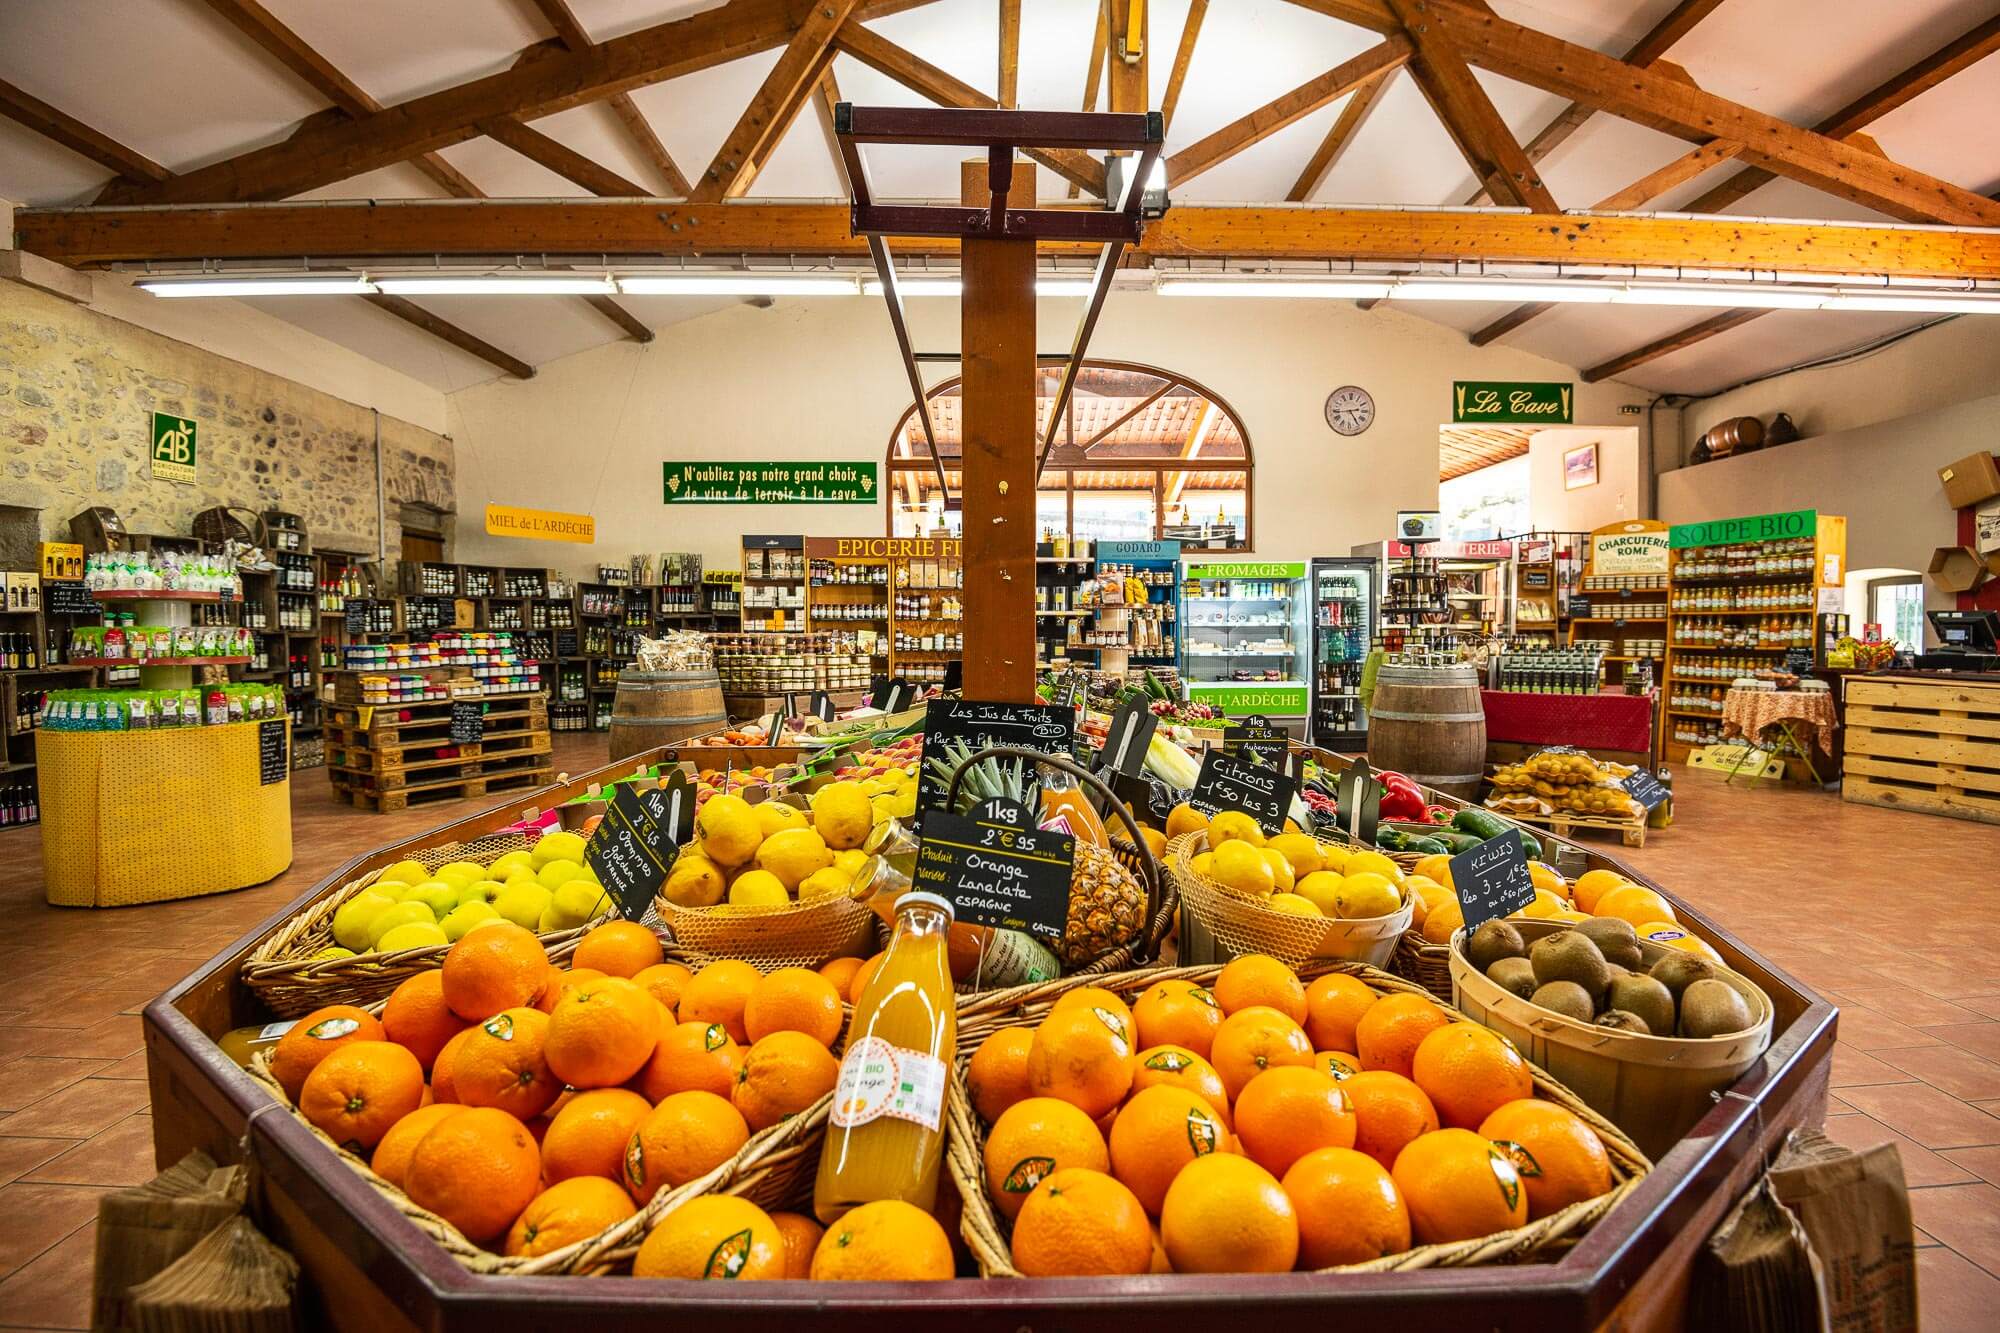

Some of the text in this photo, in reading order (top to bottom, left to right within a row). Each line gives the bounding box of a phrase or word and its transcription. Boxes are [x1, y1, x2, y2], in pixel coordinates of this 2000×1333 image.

[1467, 390, 1558, 414] La Cave
[156, 430, 190, 463] AB
[684, 466, 857, 485] N'oubliez pas notre grand choix
[684, 486, 697, 500] de
[704, 487, 728, 500] vins
[735, 486, 748, 500] de
[755, 486, 793, 501] terroir
[813, 486, 824, 500] la
[831, 490, 857, 500] cave
[489, 514, 518, 529] MIEL
[520, 517, 531, 530] de
[1678, 513, 1804, 546] SOUPE BIO
[837, 539, 935, 557] EPICERIE
[1116, 543, 1161, 553] GODARD
[1598, 536, 1670, 552] CHARCUTERIE
[1617, 547, 1649, 557] ROME
[1207, 564, 1288, 577] FROMAGES
[977, 706, 998, 720] Jus
[1017, 709, 1052, 724] Fruits
[1249, 717, 1264, 727] 1kg
[934, 731, 950, 746] Pur
[1212, 759, 1276, 790] Citrons
[648, 793, 665, 819] 1kg
[985, 800, 1018, 824] 1kg
[1267, 802, 1279, 817] 3
[966, 853, 1029, 880] Orange
[1483, 879, 1491, 895] 3
[955, 895, 1012, 912] ESPAGNE
